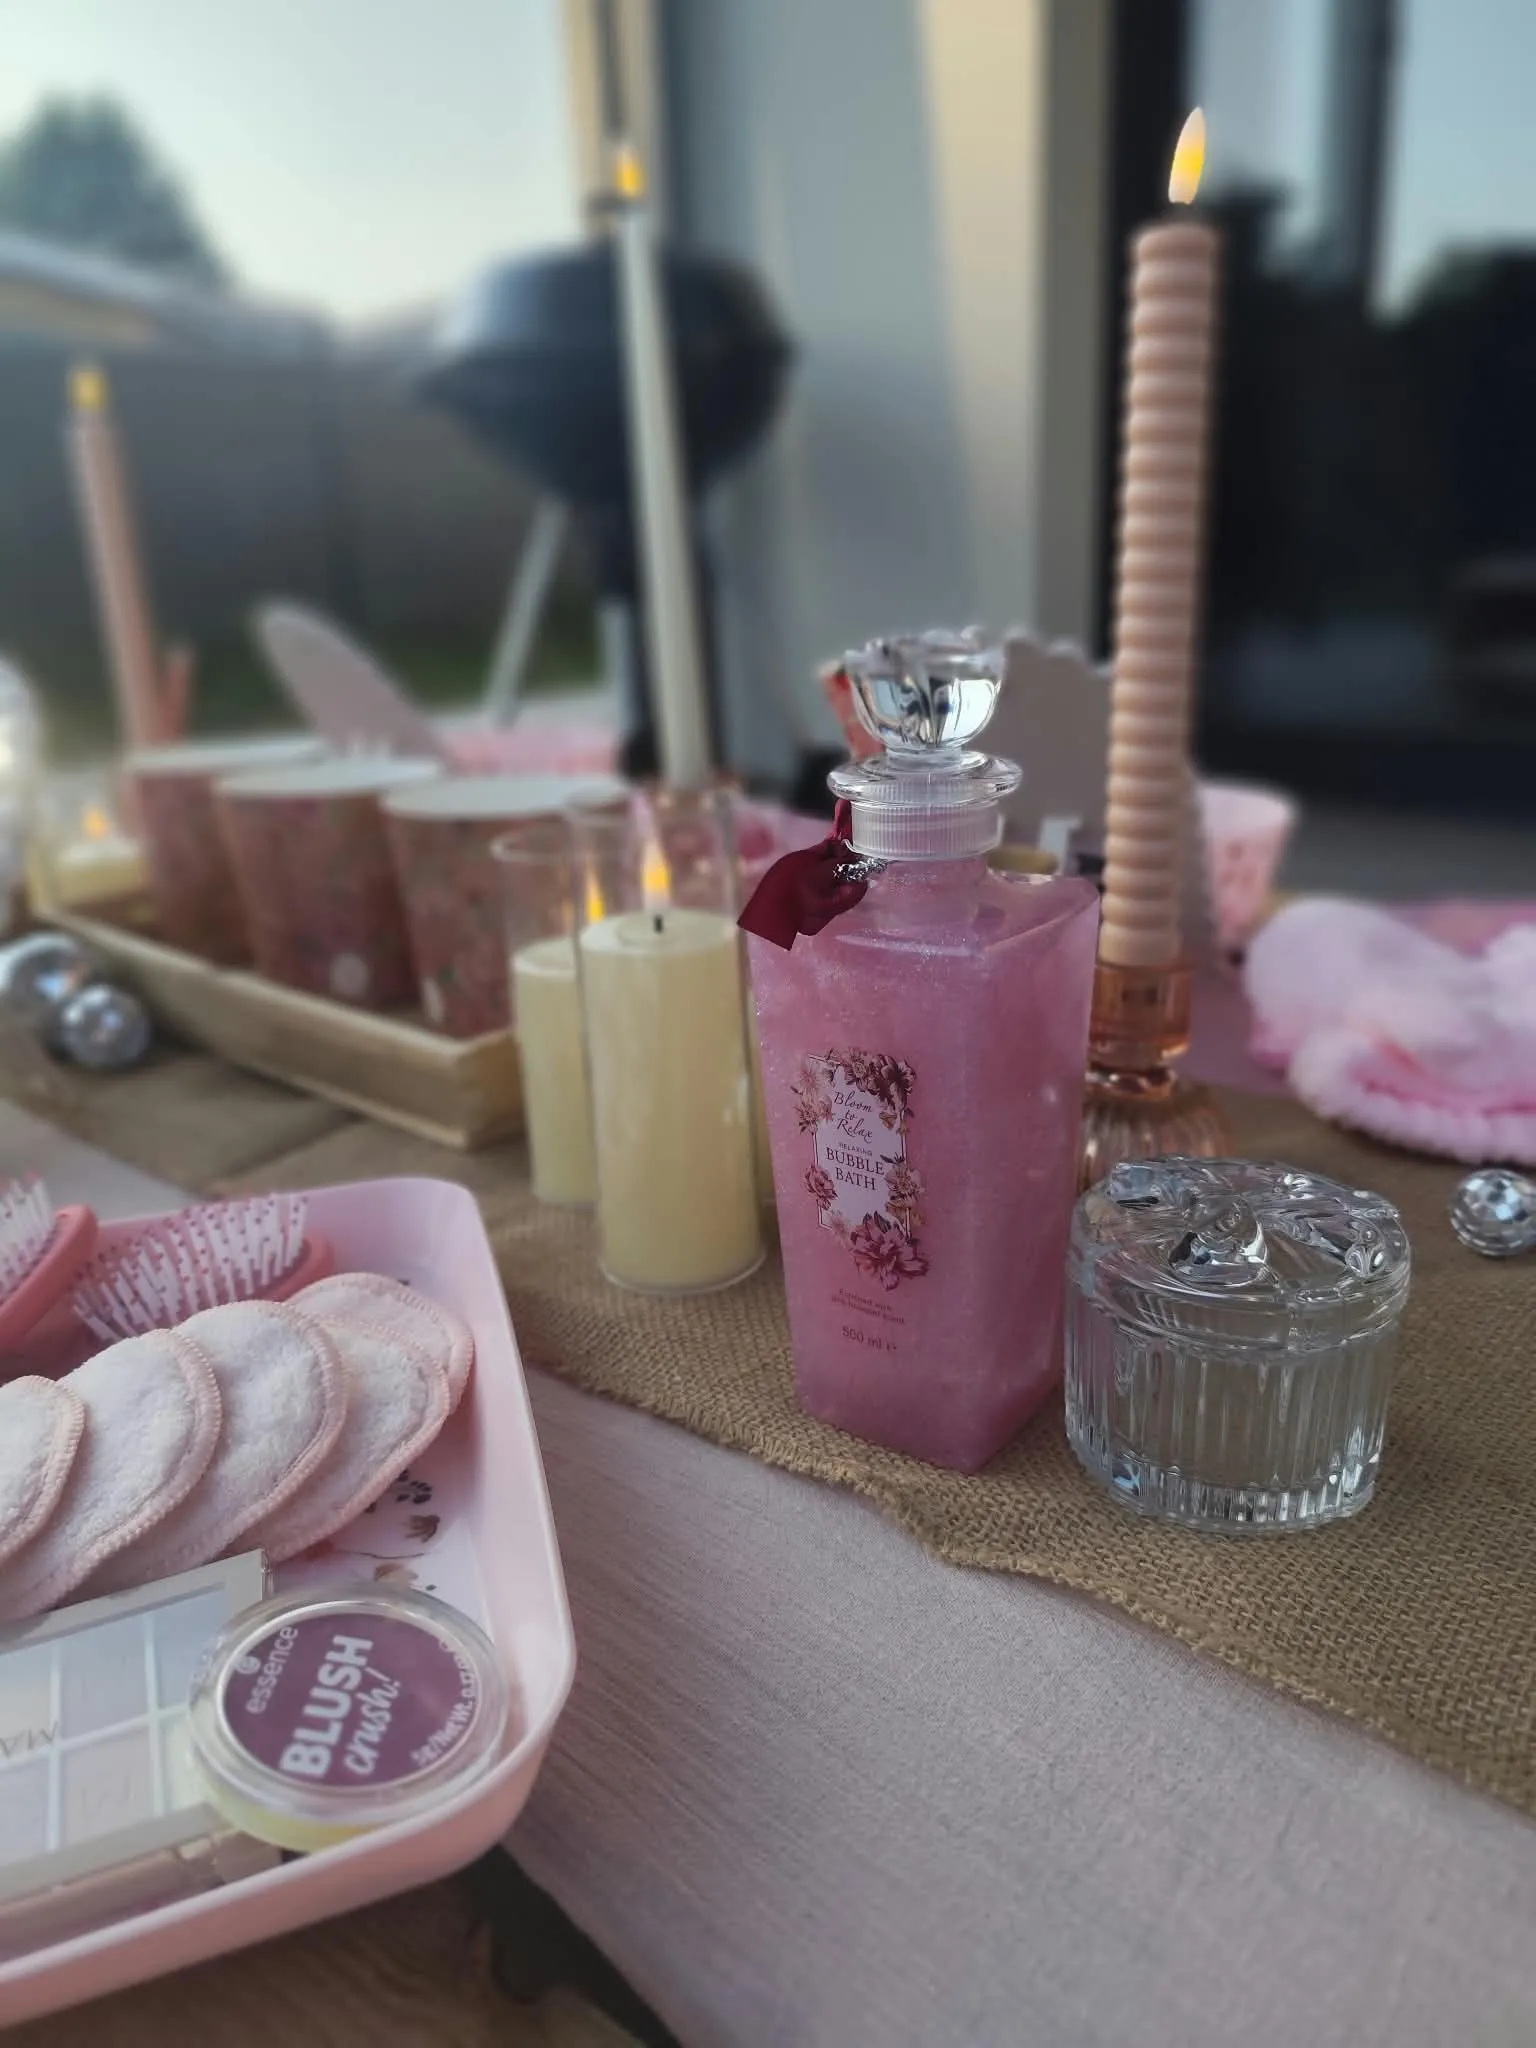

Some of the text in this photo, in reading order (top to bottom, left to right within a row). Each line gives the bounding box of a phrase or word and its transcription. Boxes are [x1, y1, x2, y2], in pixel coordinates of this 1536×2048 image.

[834, 1090, 872, 1112] Bloom
[845, 1109, 857, 1120] to
[837, 1117, 872, 1143] Relax
[826, 1147, 884, 1175] BUBBLE
[835, 1167, 876, 1190] BATH
[245, 1626, 298, 1714] essence
[280, 1635, 374, 1778] BLUSH
[344, 1667, 400, 1775] crush!
